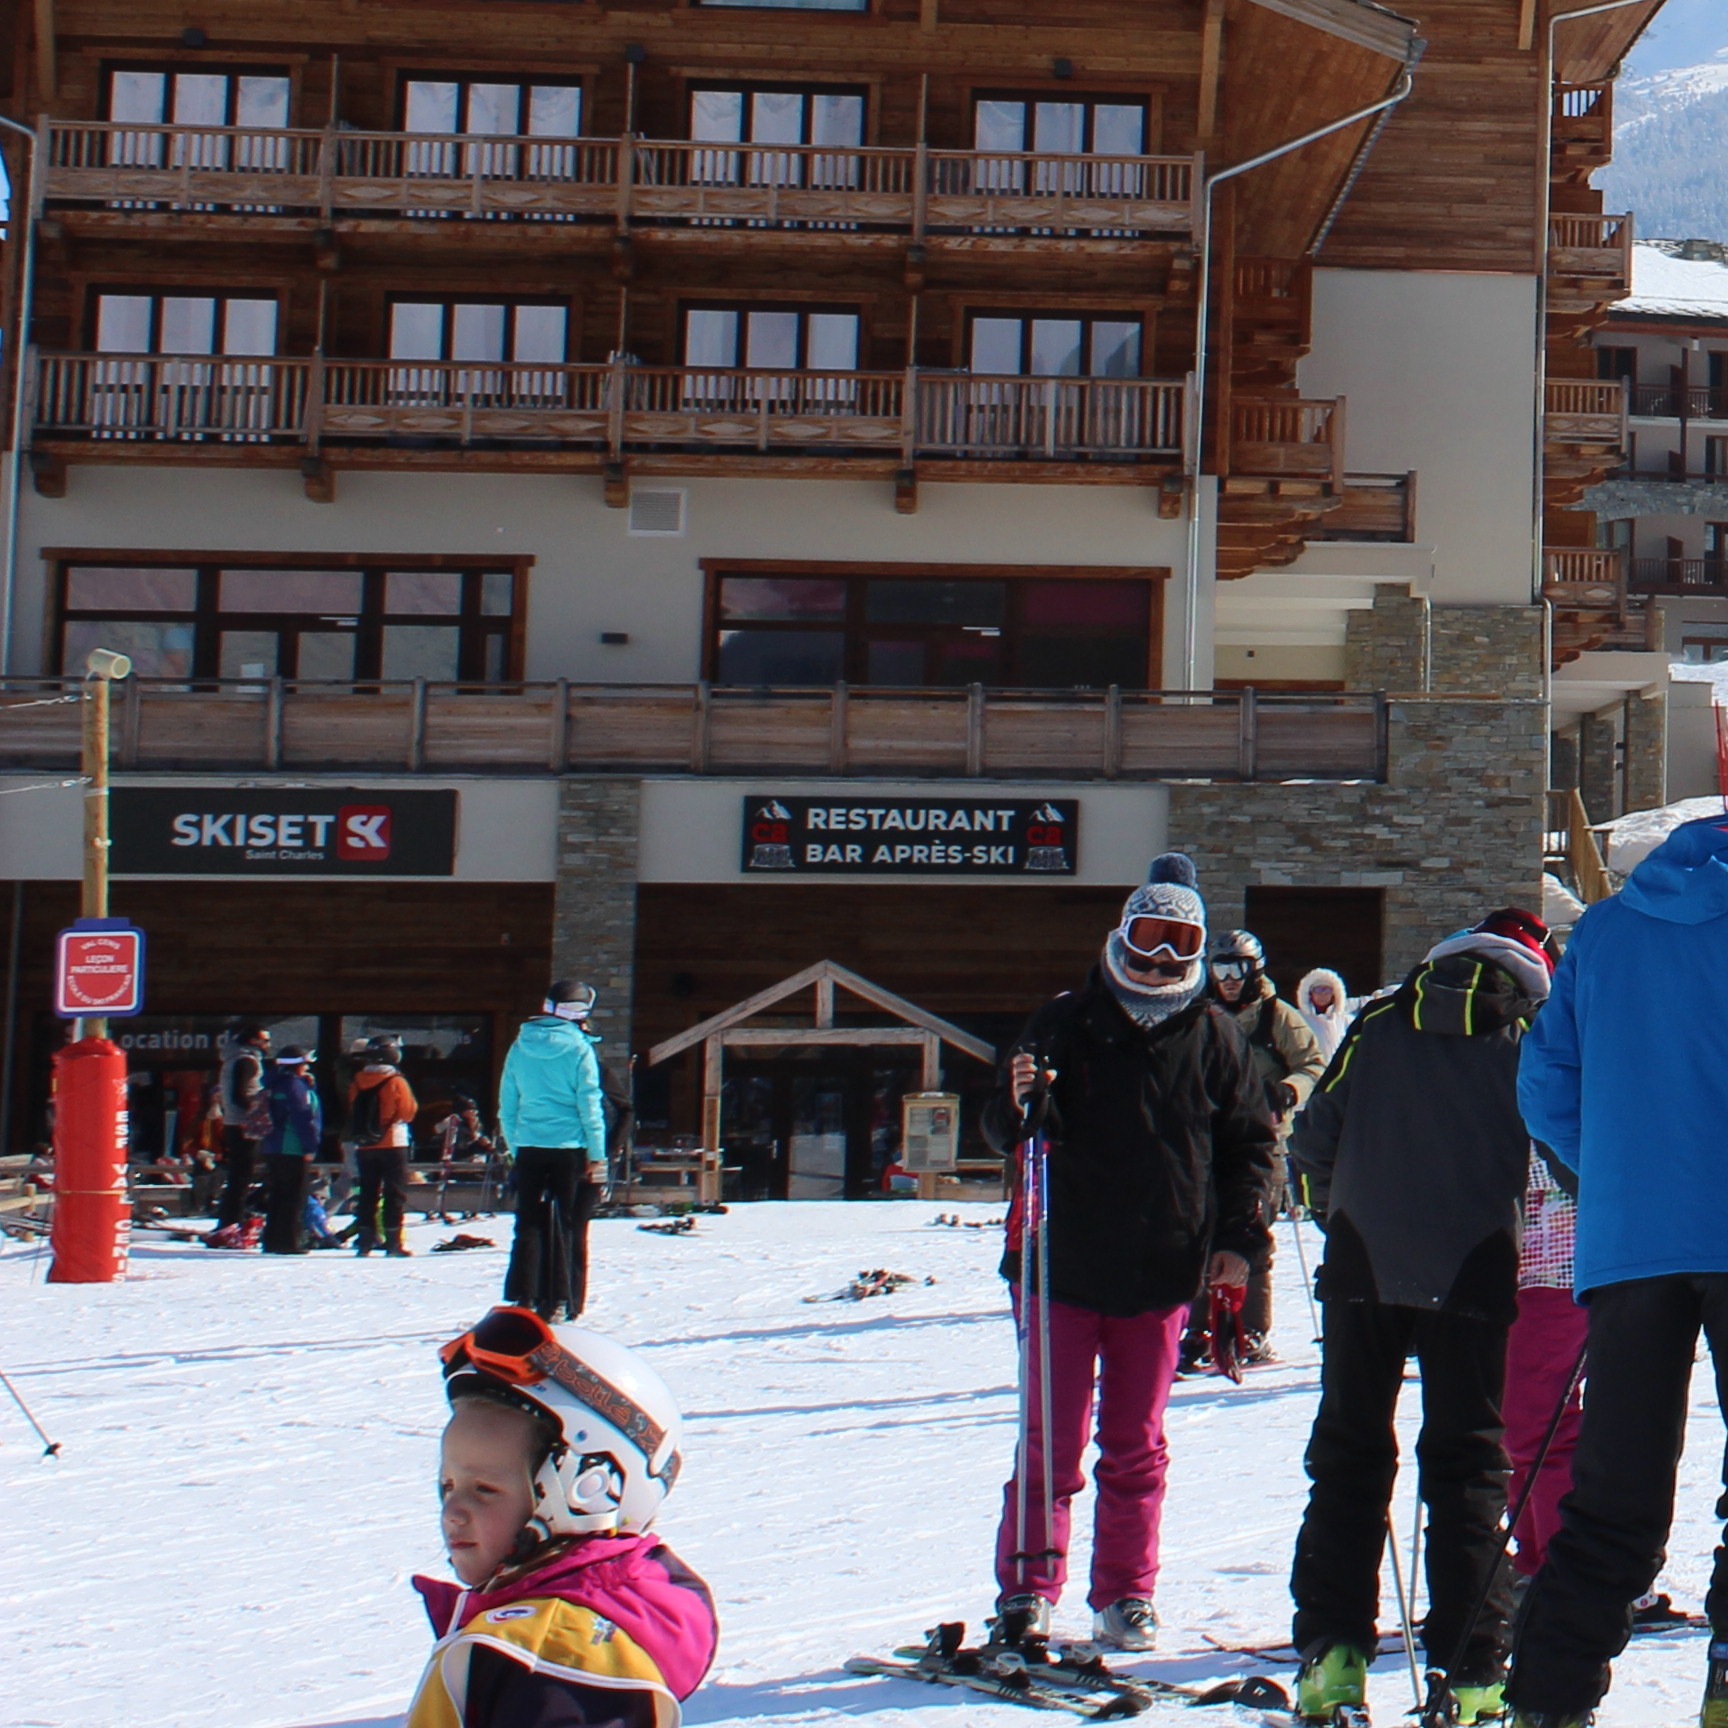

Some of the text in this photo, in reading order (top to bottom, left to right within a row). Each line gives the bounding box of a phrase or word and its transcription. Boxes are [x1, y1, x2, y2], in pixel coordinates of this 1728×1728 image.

[170, 812, 337, 848] SKISET
[805, 807, 1016, 832] RESTAURANT
[245, 849, 325, 861] Saint Charles
[805, 838, 1015, 865] BAR APRÈS-SKI
[112, 1029, 209, 1049] ocation
[111, 1110, 135, 1285] ESF VAL CENIS
